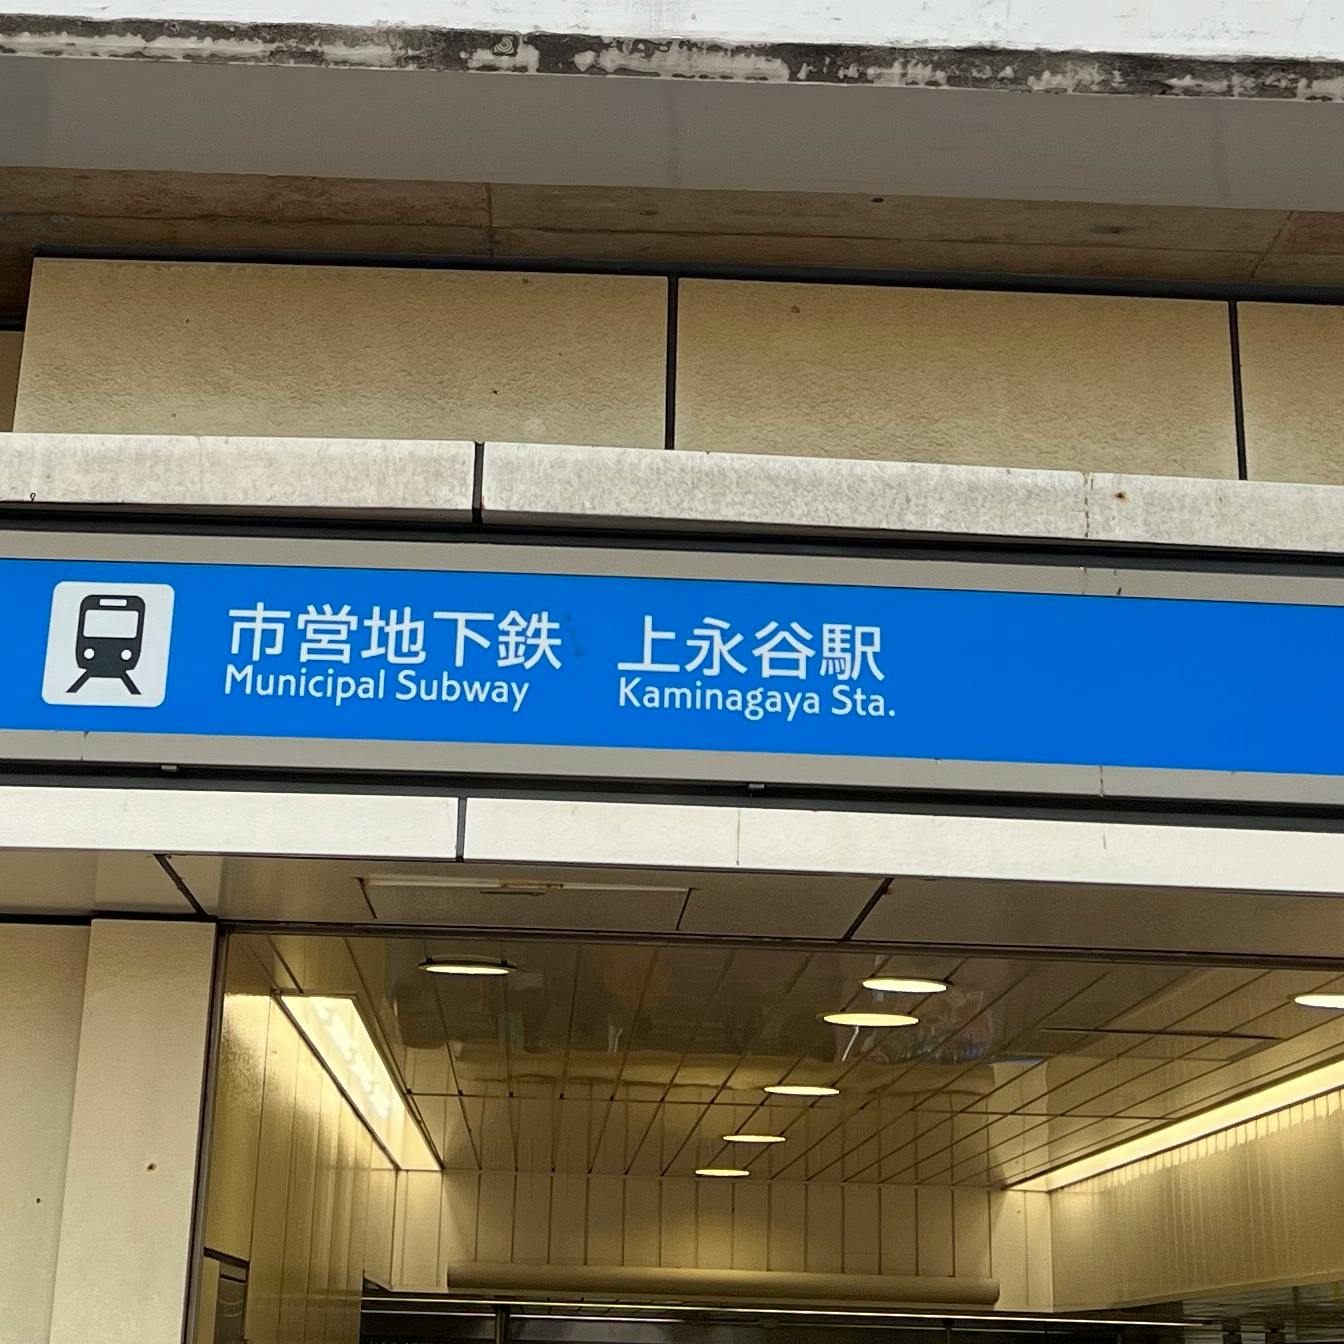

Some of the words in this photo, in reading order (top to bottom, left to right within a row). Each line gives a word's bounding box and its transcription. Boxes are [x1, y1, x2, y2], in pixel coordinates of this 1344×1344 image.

[227, 602, 561, 669] 市営地下鉄
[617, 615, 884, 681] 上永谷駅
[225, 664, 384, 705] Municipal
[396, 669, 529, 711] Subway
[619, 677, 819, 720] Kaminagaya
[832, 685, 896, 717] Sta.
